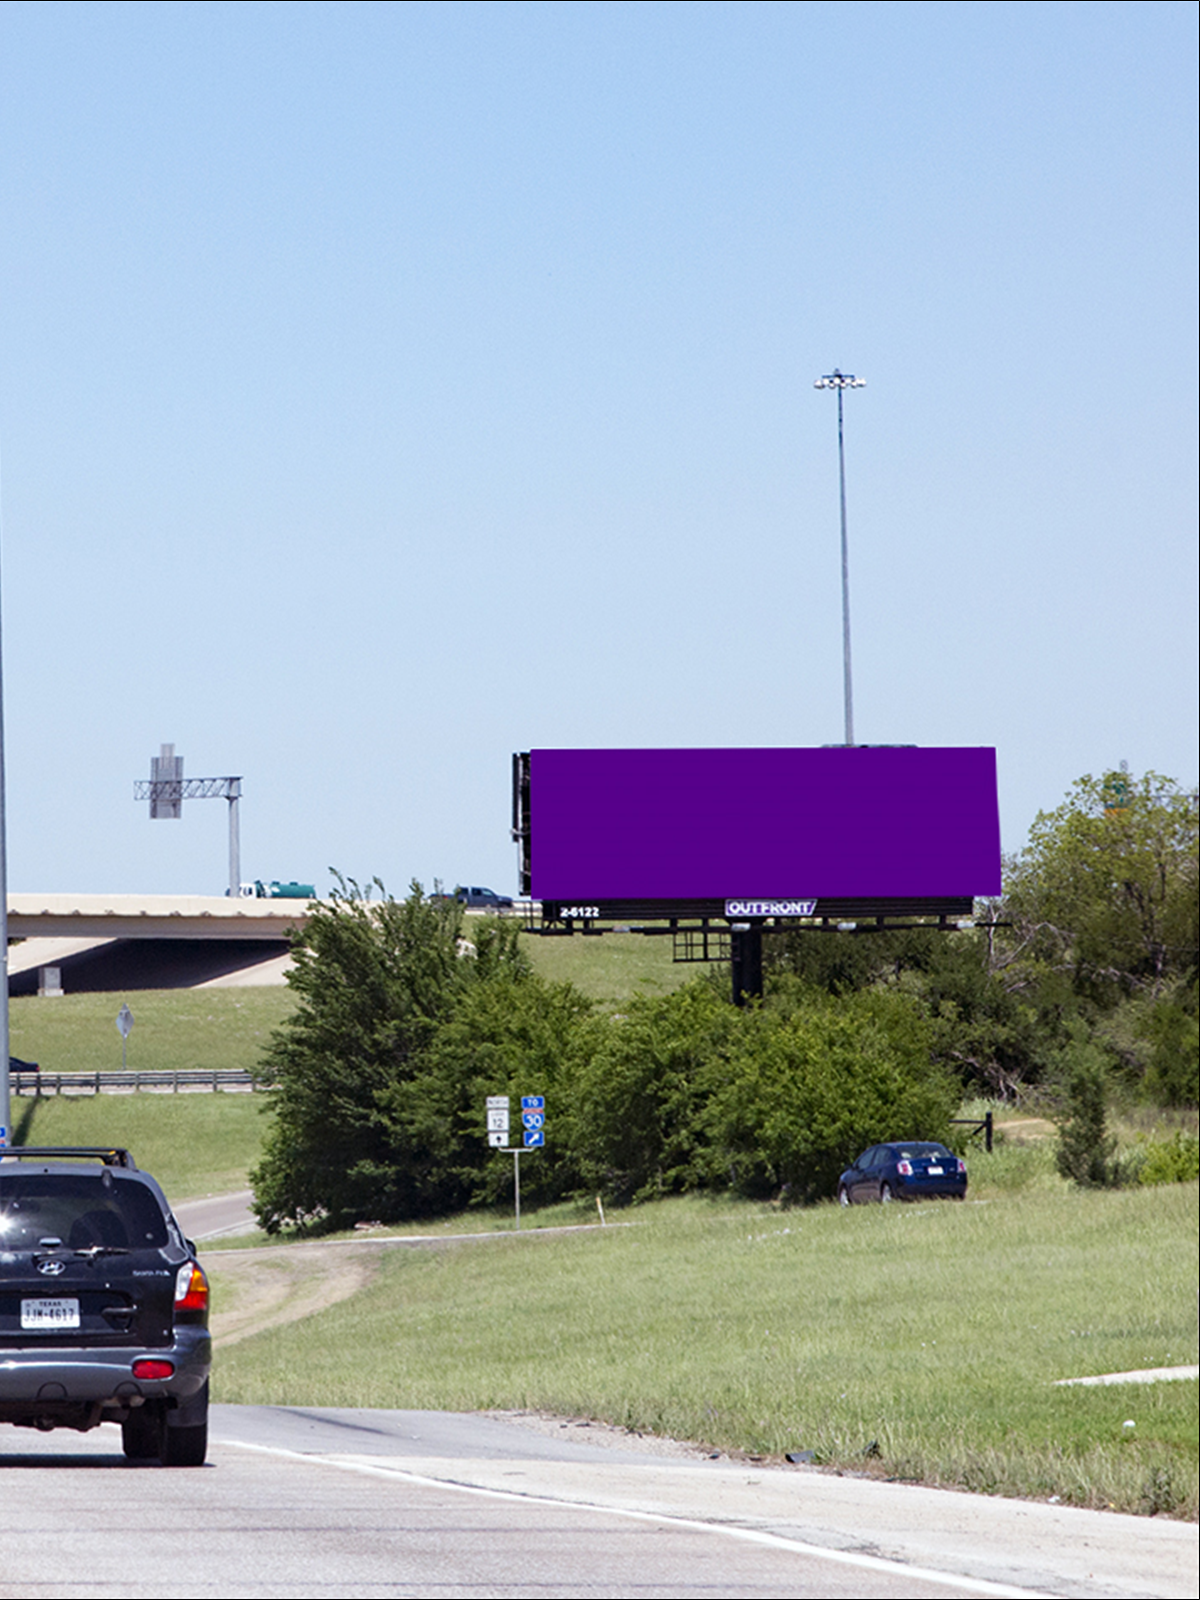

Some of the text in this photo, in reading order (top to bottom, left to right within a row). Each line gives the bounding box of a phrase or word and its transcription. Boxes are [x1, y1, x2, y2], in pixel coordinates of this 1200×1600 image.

[729, 901, 812, 915] OUTFRONT
[527, 1098, 539, 1107] TO
[493, 1117, 504, 1129] 12
[526, 1114, 542, 1127] 30
